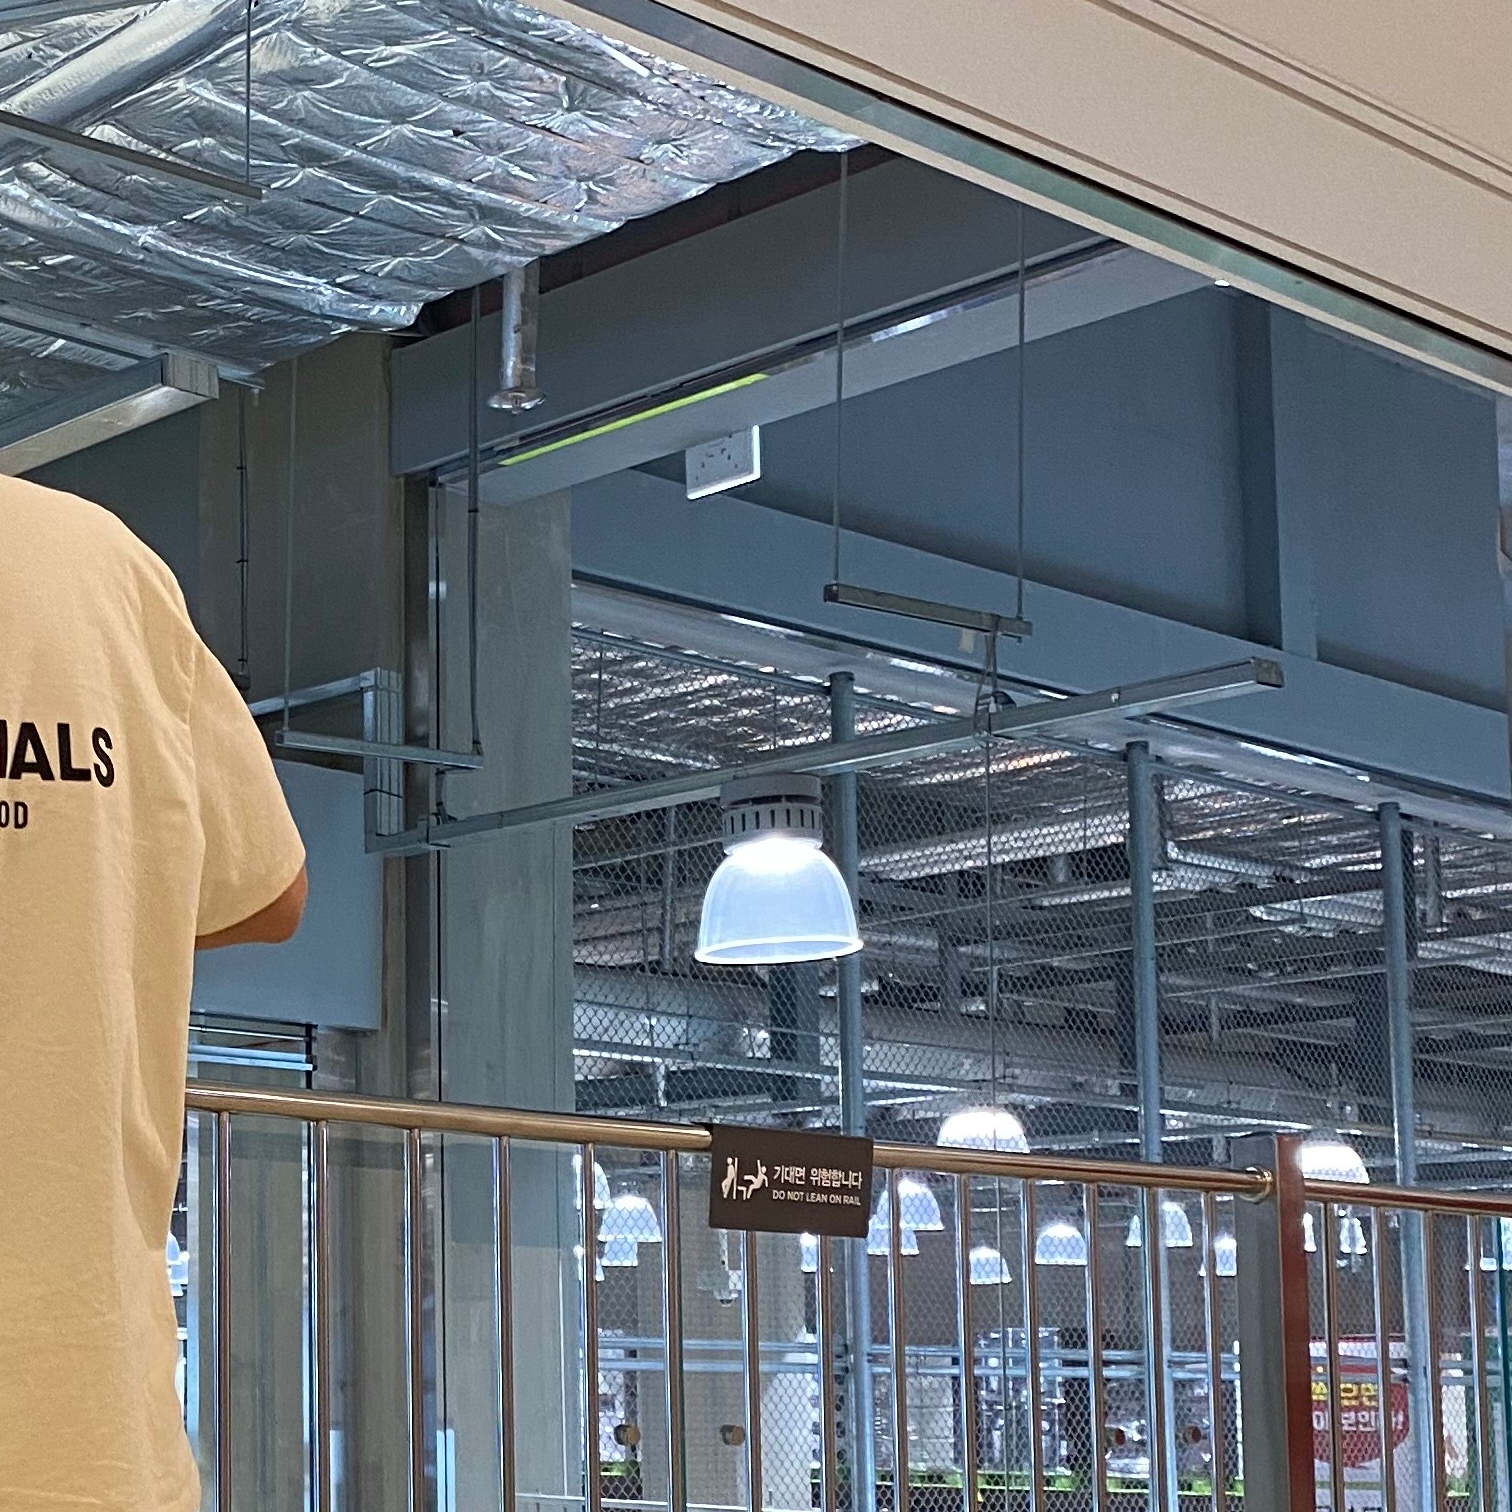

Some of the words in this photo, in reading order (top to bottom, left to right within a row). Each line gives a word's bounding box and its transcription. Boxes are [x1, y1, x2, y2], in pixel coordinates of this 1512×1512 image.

[773, 1165, 806, 1185] 기대면
[809, 1168, 863, 1190] 위험합니다
[772, 1189, 786, 1200] DO
[787, 1191, 805, 1201] NOT
[805, 1192, 828, 1204] LEAN
[829, 1195, 842, 1205] ON
[843, 1196, 861, 1206] RAIL
